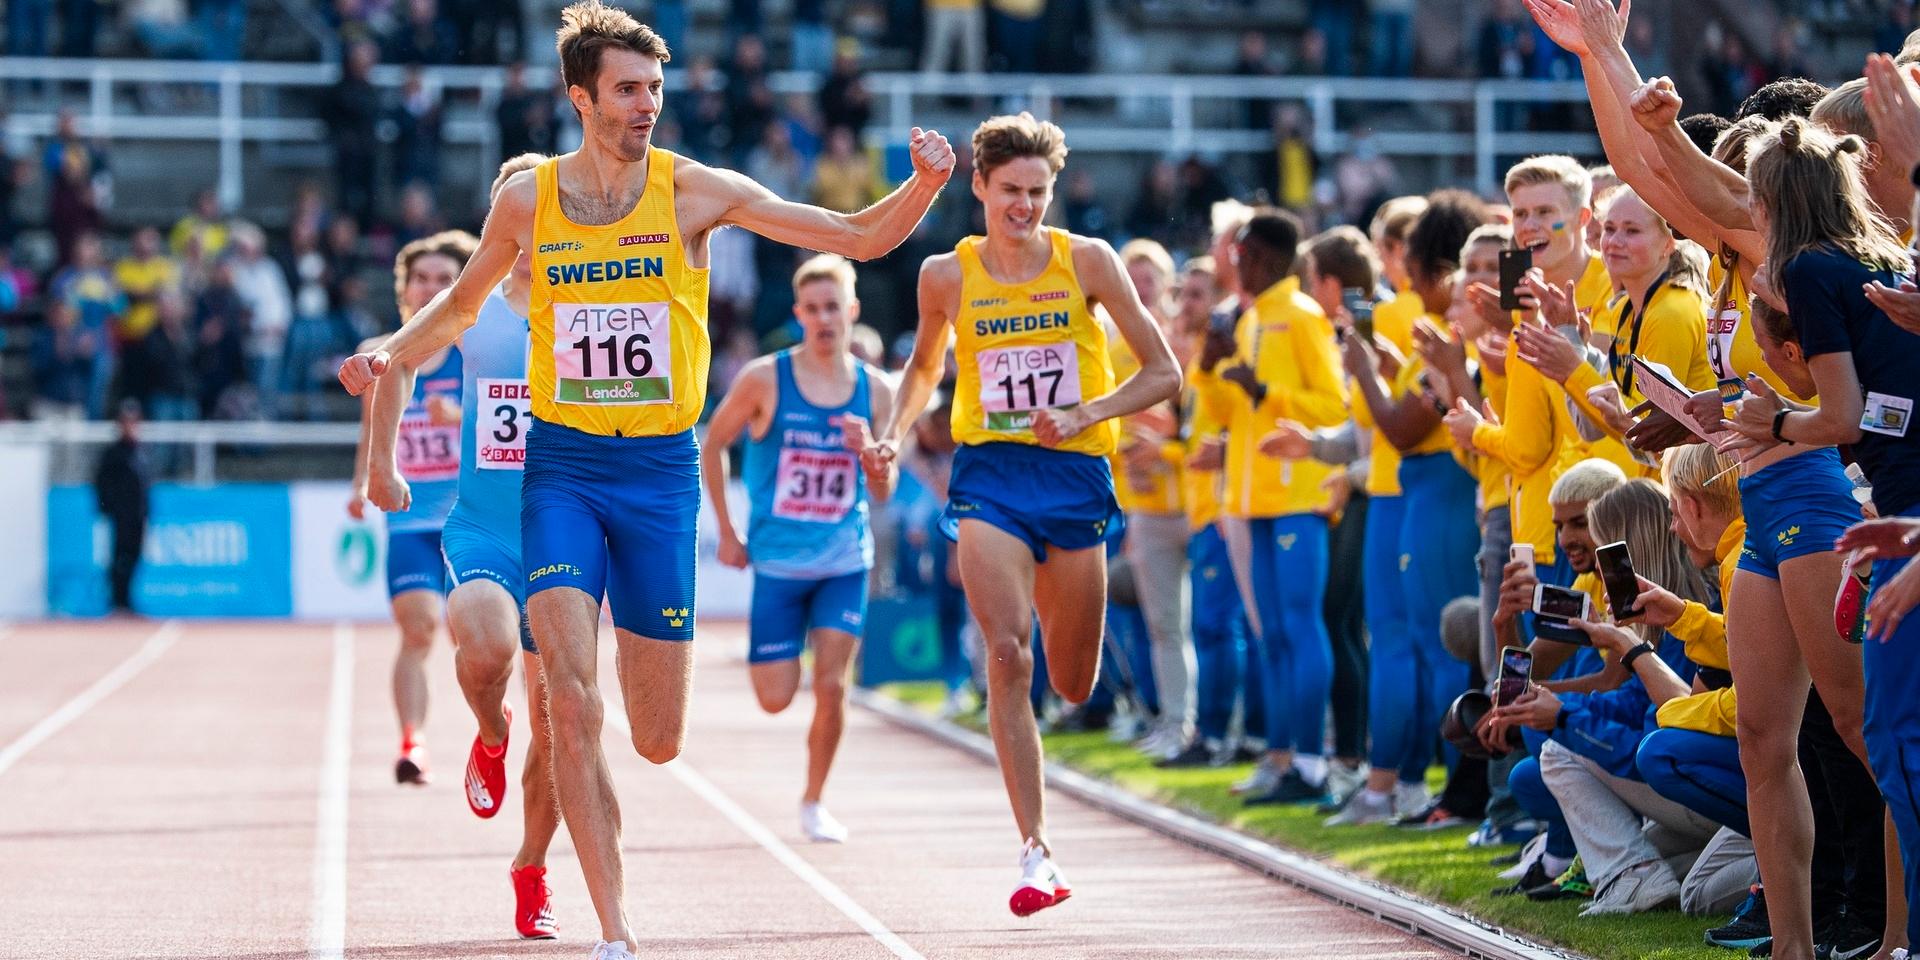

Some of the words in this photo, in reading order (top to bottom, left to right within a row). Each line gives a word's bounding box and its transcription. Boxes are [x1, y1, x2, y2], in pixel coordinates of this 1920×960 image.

[539, 242, 574, 253] CRAFT
[619, 234, 669, 246] BAUHAUS
[547, 257, 663, 286] SWEDEN
[569, 308, 652, 332] ATEA
[976, 312, 1068, 336] SWEDEN
[573, 334, 653, 377] 116
[994, 349, 1063, 372] ATEA
[490, 386, 531, 398] CRA
[998, 370, 1063, 409] 117
[493, 405, 533, 443] 3
[784, 429, 846, 449] FINLA
[494, 450, 526, 461] BAU
[790, 469, 845, 499] 314
[530, 564, 571, 581] CRAFT
